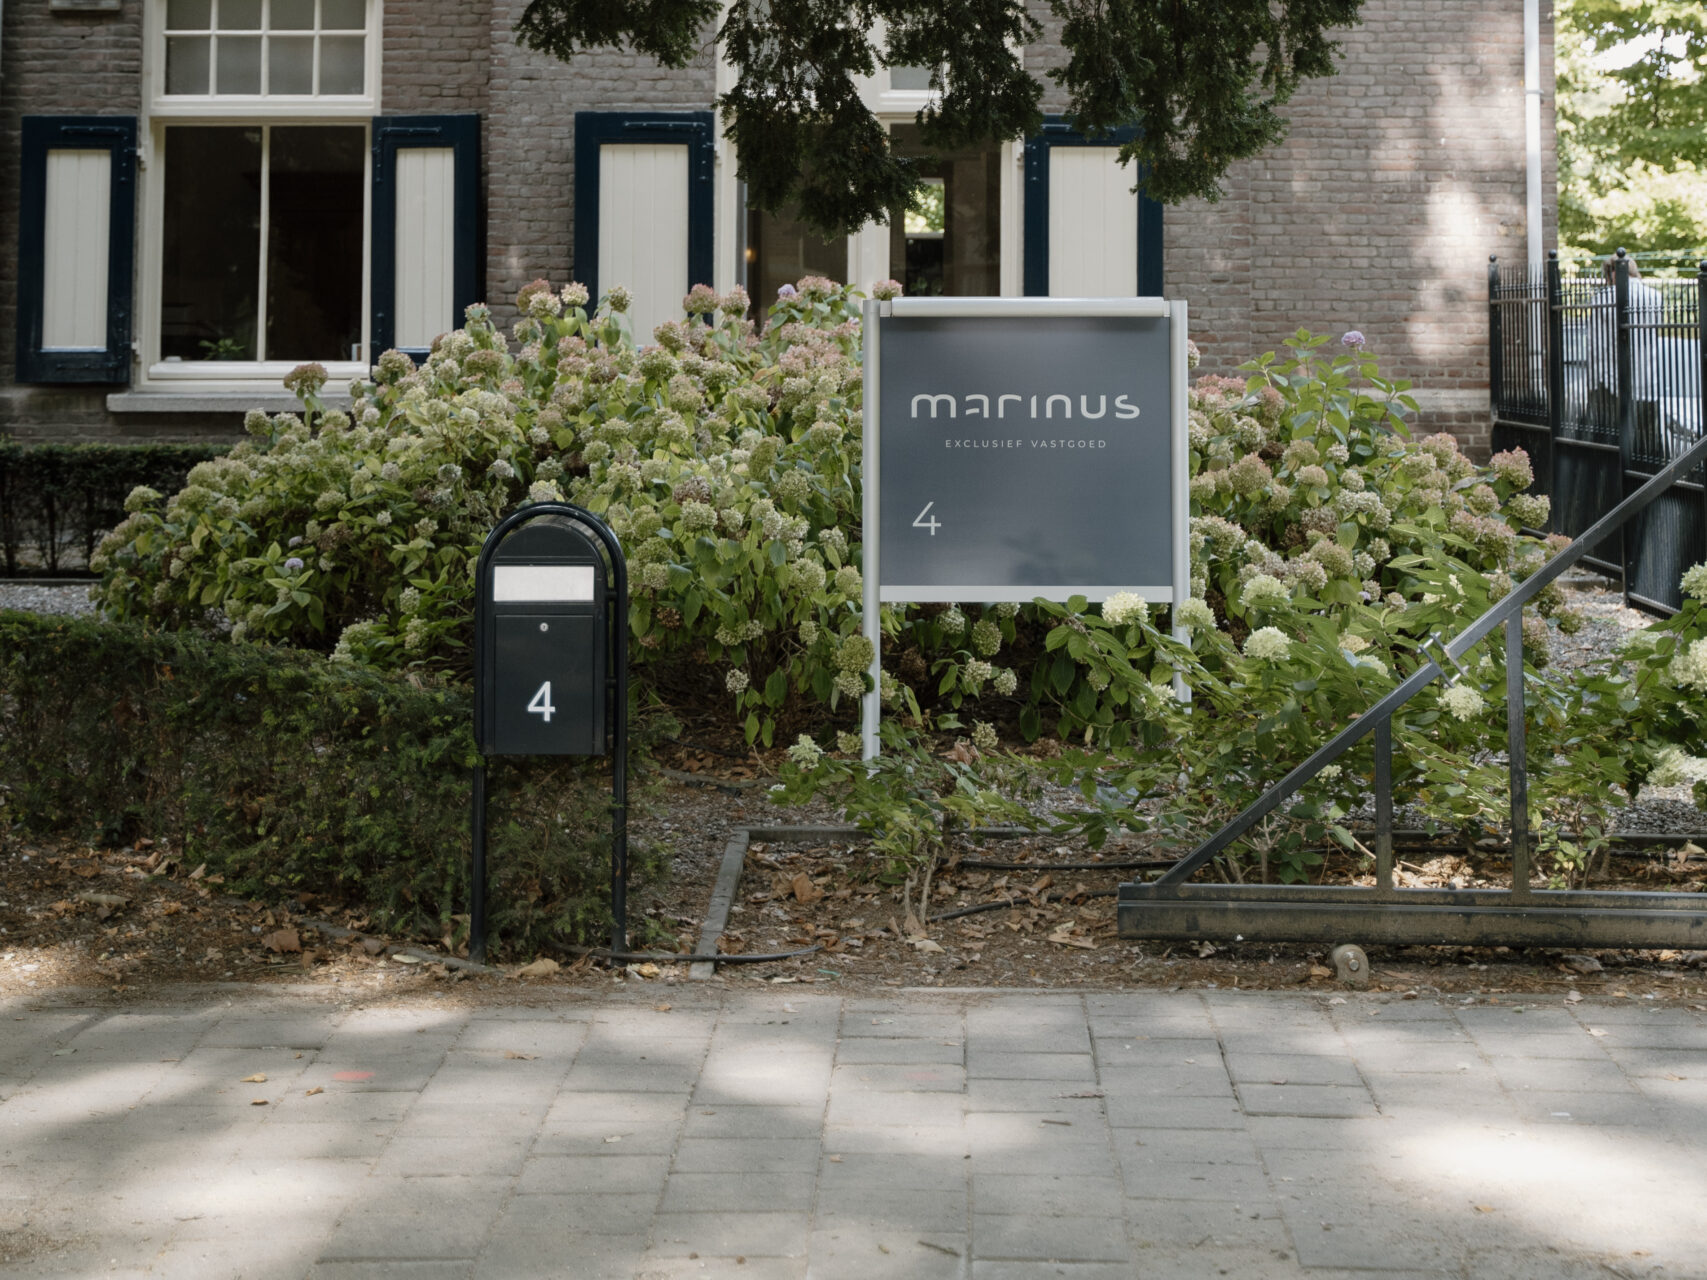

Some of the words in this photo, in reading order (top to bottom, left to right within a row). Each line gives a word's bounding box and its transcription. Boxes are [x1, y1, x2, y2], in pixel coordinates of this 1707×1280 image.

[910, 393, 1141, 420] marinus
[945, 439, 1023, 449] EXCLUSIEF
[1030, 439, 1107, 449] VASTGOED
[912, 501, 942, 536] 4
[526, 680, 556, 723] 4
